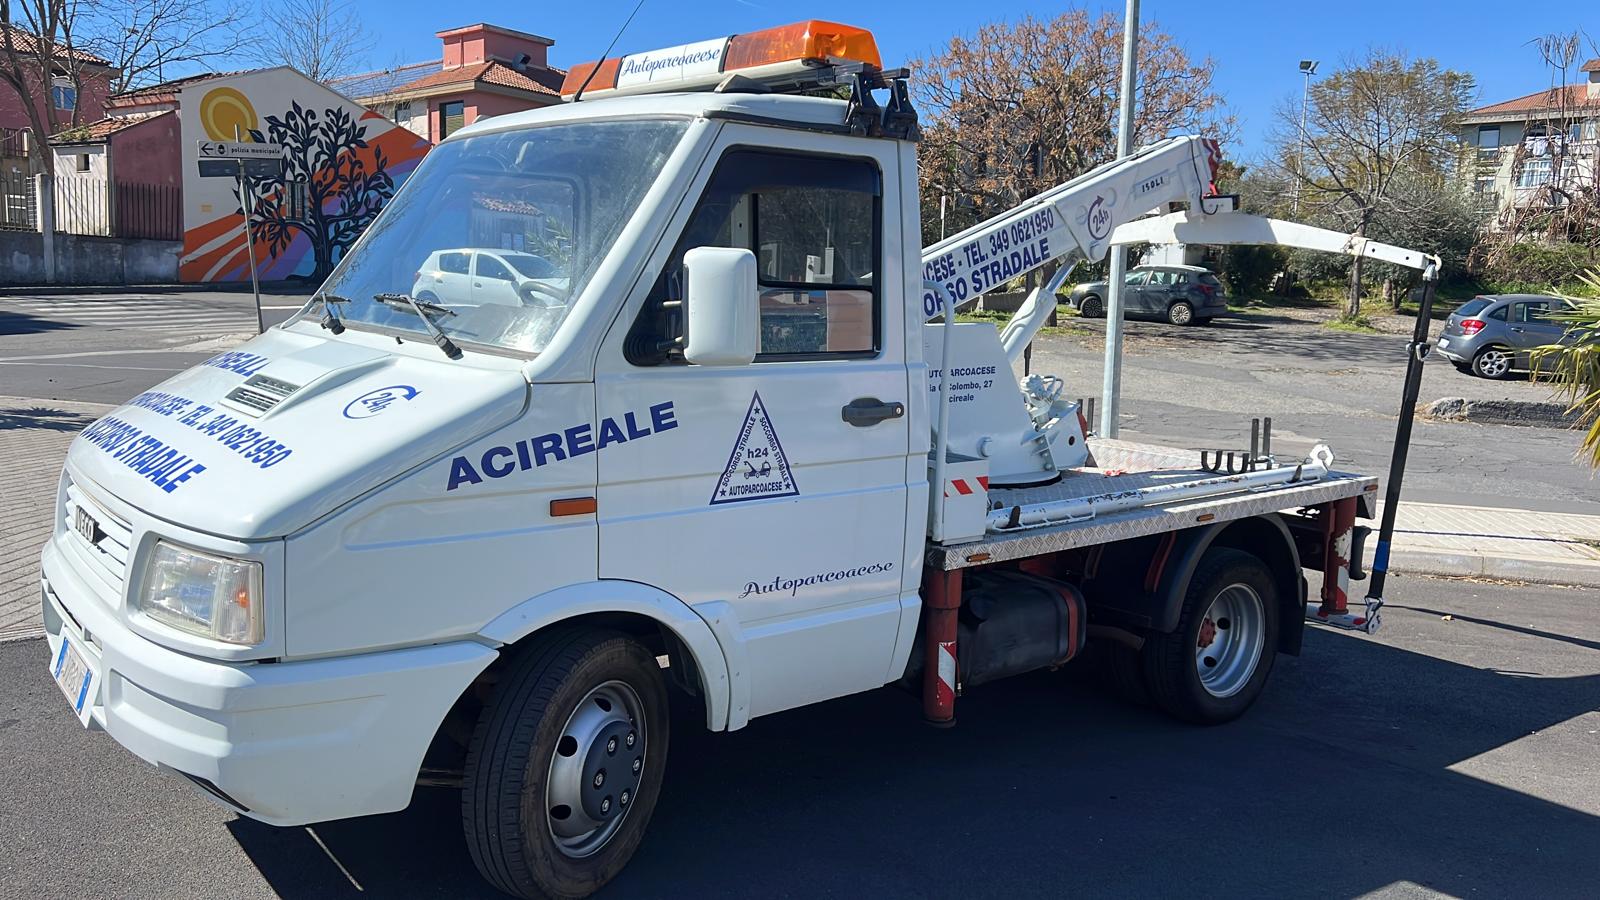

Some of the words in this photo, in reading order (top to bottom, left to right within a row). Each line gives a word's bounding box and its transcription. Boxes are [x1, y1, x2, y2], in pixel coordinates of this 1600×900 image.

[621, 49, 720, 81] Autoparcoacese
[231, 146, 249, 155] polizia
[250, 147, 280, 156] municipale
[1142, 176, 1164, 193] ISOLI
[1092, 208, 1109, 234] 24h
[963, 240, 989, 268] TEL.
[989, 229, 1010, 257] 349
[1011, 207, 1054, 246] 0621950
[971, 237, 1051, 294] STRADALE
[983, 380, 993, 389] 27
[361, 392, 397, 413] 24h
[948, 393, 975, 403] cireale
[176, 405, 215, 428] TEL.
[196, 414, 239, 436] 349
[217, 424, 293, 469] 0621950
[446, 401, 679, 491] ACIREALE
[759, 416, 778, 452] SOCCORSO
[113, 434, 207, 494] STRADALE
[722, 451, 743, 488] SOCCORSO
[738, 416, 757, 452] STRADALE
[747, 447, 769, 459] h24
[728, 481, 783, 497] AUTOPARCOACESE
[738, 562, 893, 599] Autoparcoacese
